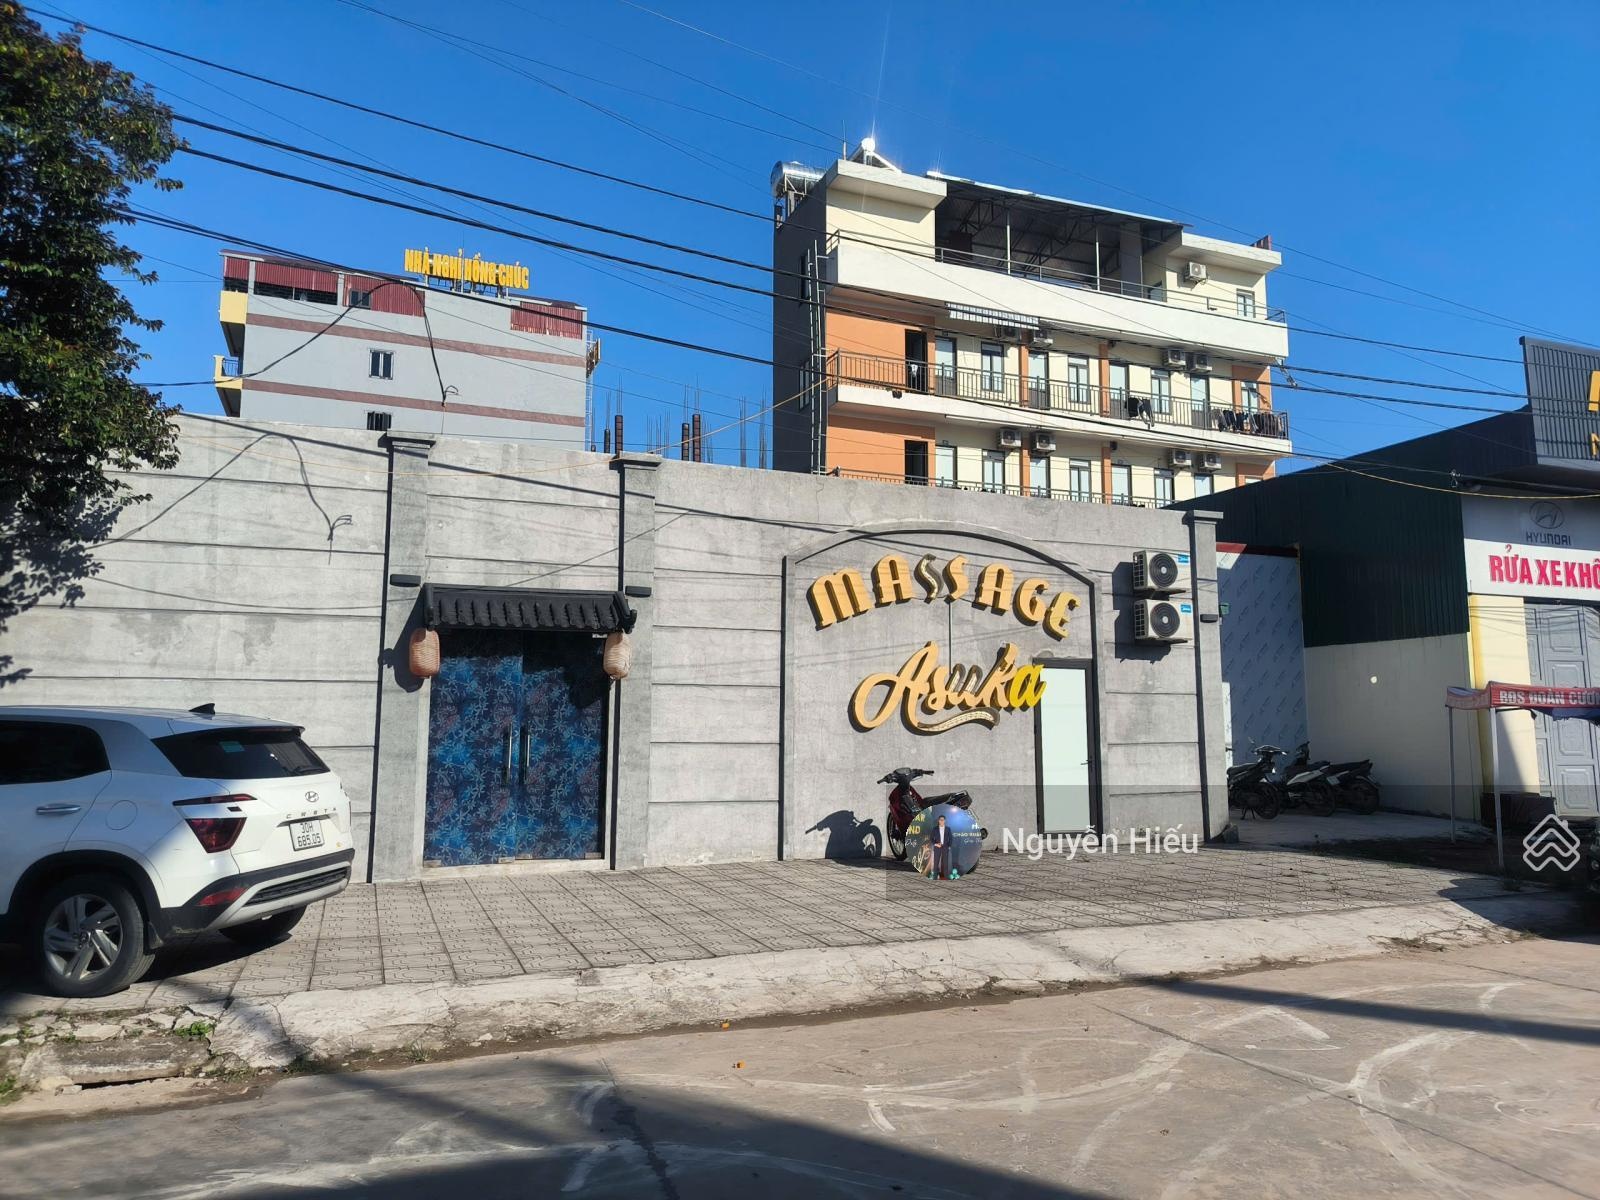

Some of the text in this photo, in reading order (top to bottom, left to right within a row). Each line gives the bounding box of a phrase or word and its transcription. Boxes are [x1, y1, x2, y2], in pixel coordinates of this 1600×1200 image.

[404, 246, 431, 275] NHÀ
[432, 248, 462, 278] NGHỈ
[1526, 531, 1572, 546] HYUNDAI
[1488, 544, 1533, 585] RỬA
[1535, 559, 1562, 586] XE
[807, 553, 1081, 641] MASSAGE
[848, 641, 1047, 736] Asuka
